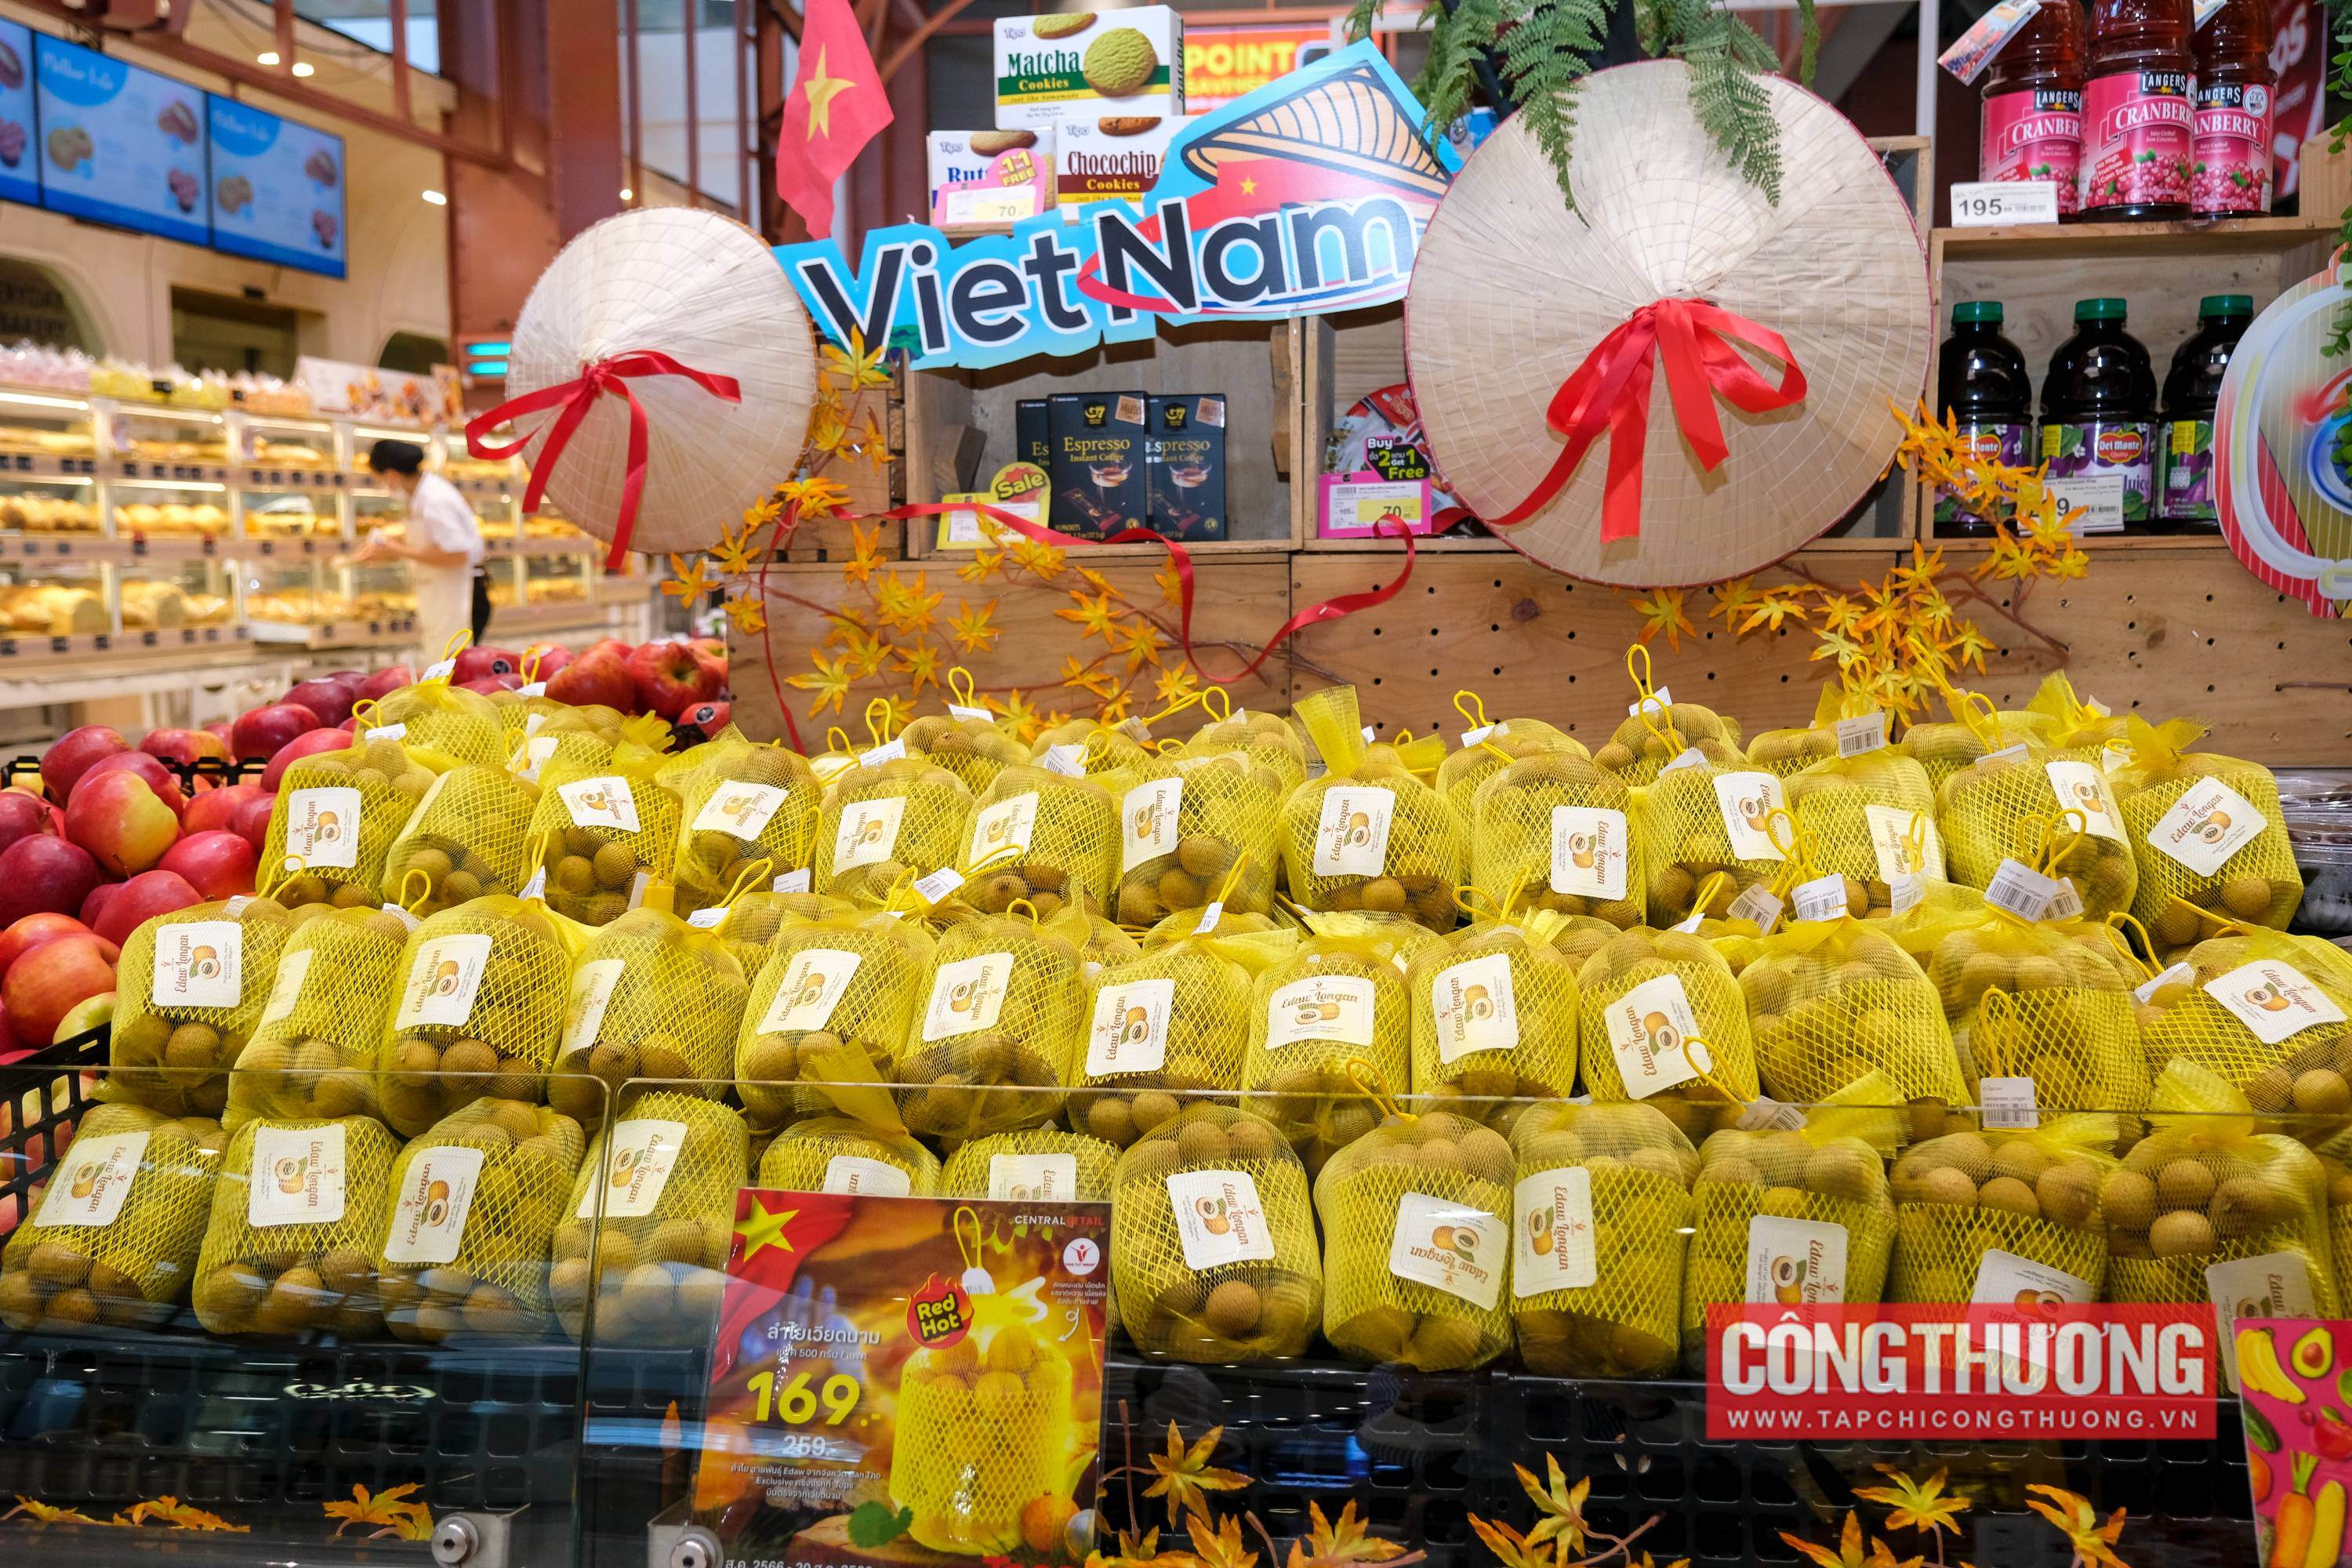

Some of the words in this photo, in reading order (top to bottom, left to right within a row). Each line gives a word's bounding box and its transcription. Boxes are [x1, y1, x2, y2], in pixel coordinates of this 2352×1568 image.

[1008, 50, 1081, 77] Matcha
[1185, 42, 1297, 75] POINT
[1019, 78, 1069, 92] Cookies
[2142, 72, 2186, 92] LANGERS
[2198, 87, 2240, 102] ANGERS
[2036, 90, 2078, 107] LANGERS
[1066, 125, 1090, 136] Tipo
[2013, 118, 2079, 144] CRANBER
[941, 142, 963, 154] Tipo
[1003, 167, 1036, 187] FREE
[1068, 151, 1156, 179] Chocochip
[1087, 179, 1140, 190] Cookies
[999, 206, 1016, 216] 70
[1959, 198, 2002, 216] 195
[801, 234, 1090, 362] Viet
[1099, 202, 1403, 321] Nam
[1084, 405, 1106, 419] G7
[1165, 408, 1186, 420] G7
[1063, 437, 1131, 456] Espresso
[1367, 438, 1392, 450] Buy
[1379, 451, 1390, 466] 2
[1406, 449, 1414, 464] 1
[2100, 440, 2113, 450] Del
[2114, 440, 2140, 450] Monte
[995, 471, 1046, 500] Sale
[1388, 466, 1424, 480] Free
[1156, 789, 1167, 814] Edaw
[304, 800, 318, 831] Longan
[1154, 812, 1163, 845] Longan
[1336, 799, 1350, 833] Longan
[2170, 818, 2196, 844] Edaw
[2193, 793, 2224, 820] Longan
[302, 833, 313, 857] Edaw
[1330, 833, 1343, 862] Edaw
[1598, 821, 1610, 848] Edaw
[1594, 848, 1606, 884] Longan
[179, 935, 190, 966] Longan
[174, 966, 187, 993] Edaw
[979, 965, 994, 989] Edaw
[2261, 968, 2288, 988] Edaw
[2285, 984, 2317, 1013] Longan
[971, 989, 988, 1021] Longan
[1280, 994, 1312, 1010] Edaw
[1314, 989, 1359, 1004] Longan
[1450, 976, 1465, 1014] Longan
[1110, 995, 1127, 1031] Longan
[1626, 1005, 1646, 1045] Longan
[1453, 1014, 1466, 1041] Edaw
[1105, 1033, 1120, 1062] Edaw
[1635, 1044, 1657, 1076] Edaw
[106, 1145, 127, 1175] Edaw
[308, 1141, 324, 1168] Edaw
[643, 1133, 664, 1167] Edaw
[86, 1173, 113, 1214] Longan
[305, 1168, 321, 1208] Longan
[626, 1164, 653, 1204] Longan
[406, 1207, 422, 1246] Edaw
[414, 1163, 432, 1208] Longan
[1221, 1181, 1238, 1208] Edaw
[1230, 1207, 1250, 1246] Longan
[1552, 1185, 1567, 1221] Edaw
[1014, 1215, 1065, 1225] CENTRAL
[1067, 1217, 1104, 1225] RETAIL
[1410, 1245, 1459, 1269] Longan
[1554, 1221, 1570, 1272] Longan
[1809, 1239, 1824, 1281] Edaw
[1457, 1259, 1489, 1286] Edaw
[917, 1293, 955, 1320] Red
[768, 1321, 880, 1345] ลำไยเวียดนาม
[921, 1313, 960, 1338] Hot
[800, 1348, 817, 1358] 500
[757, 1477, 794, 1486] Exclusive
[784, 1468, 804, 1476] Edaw
